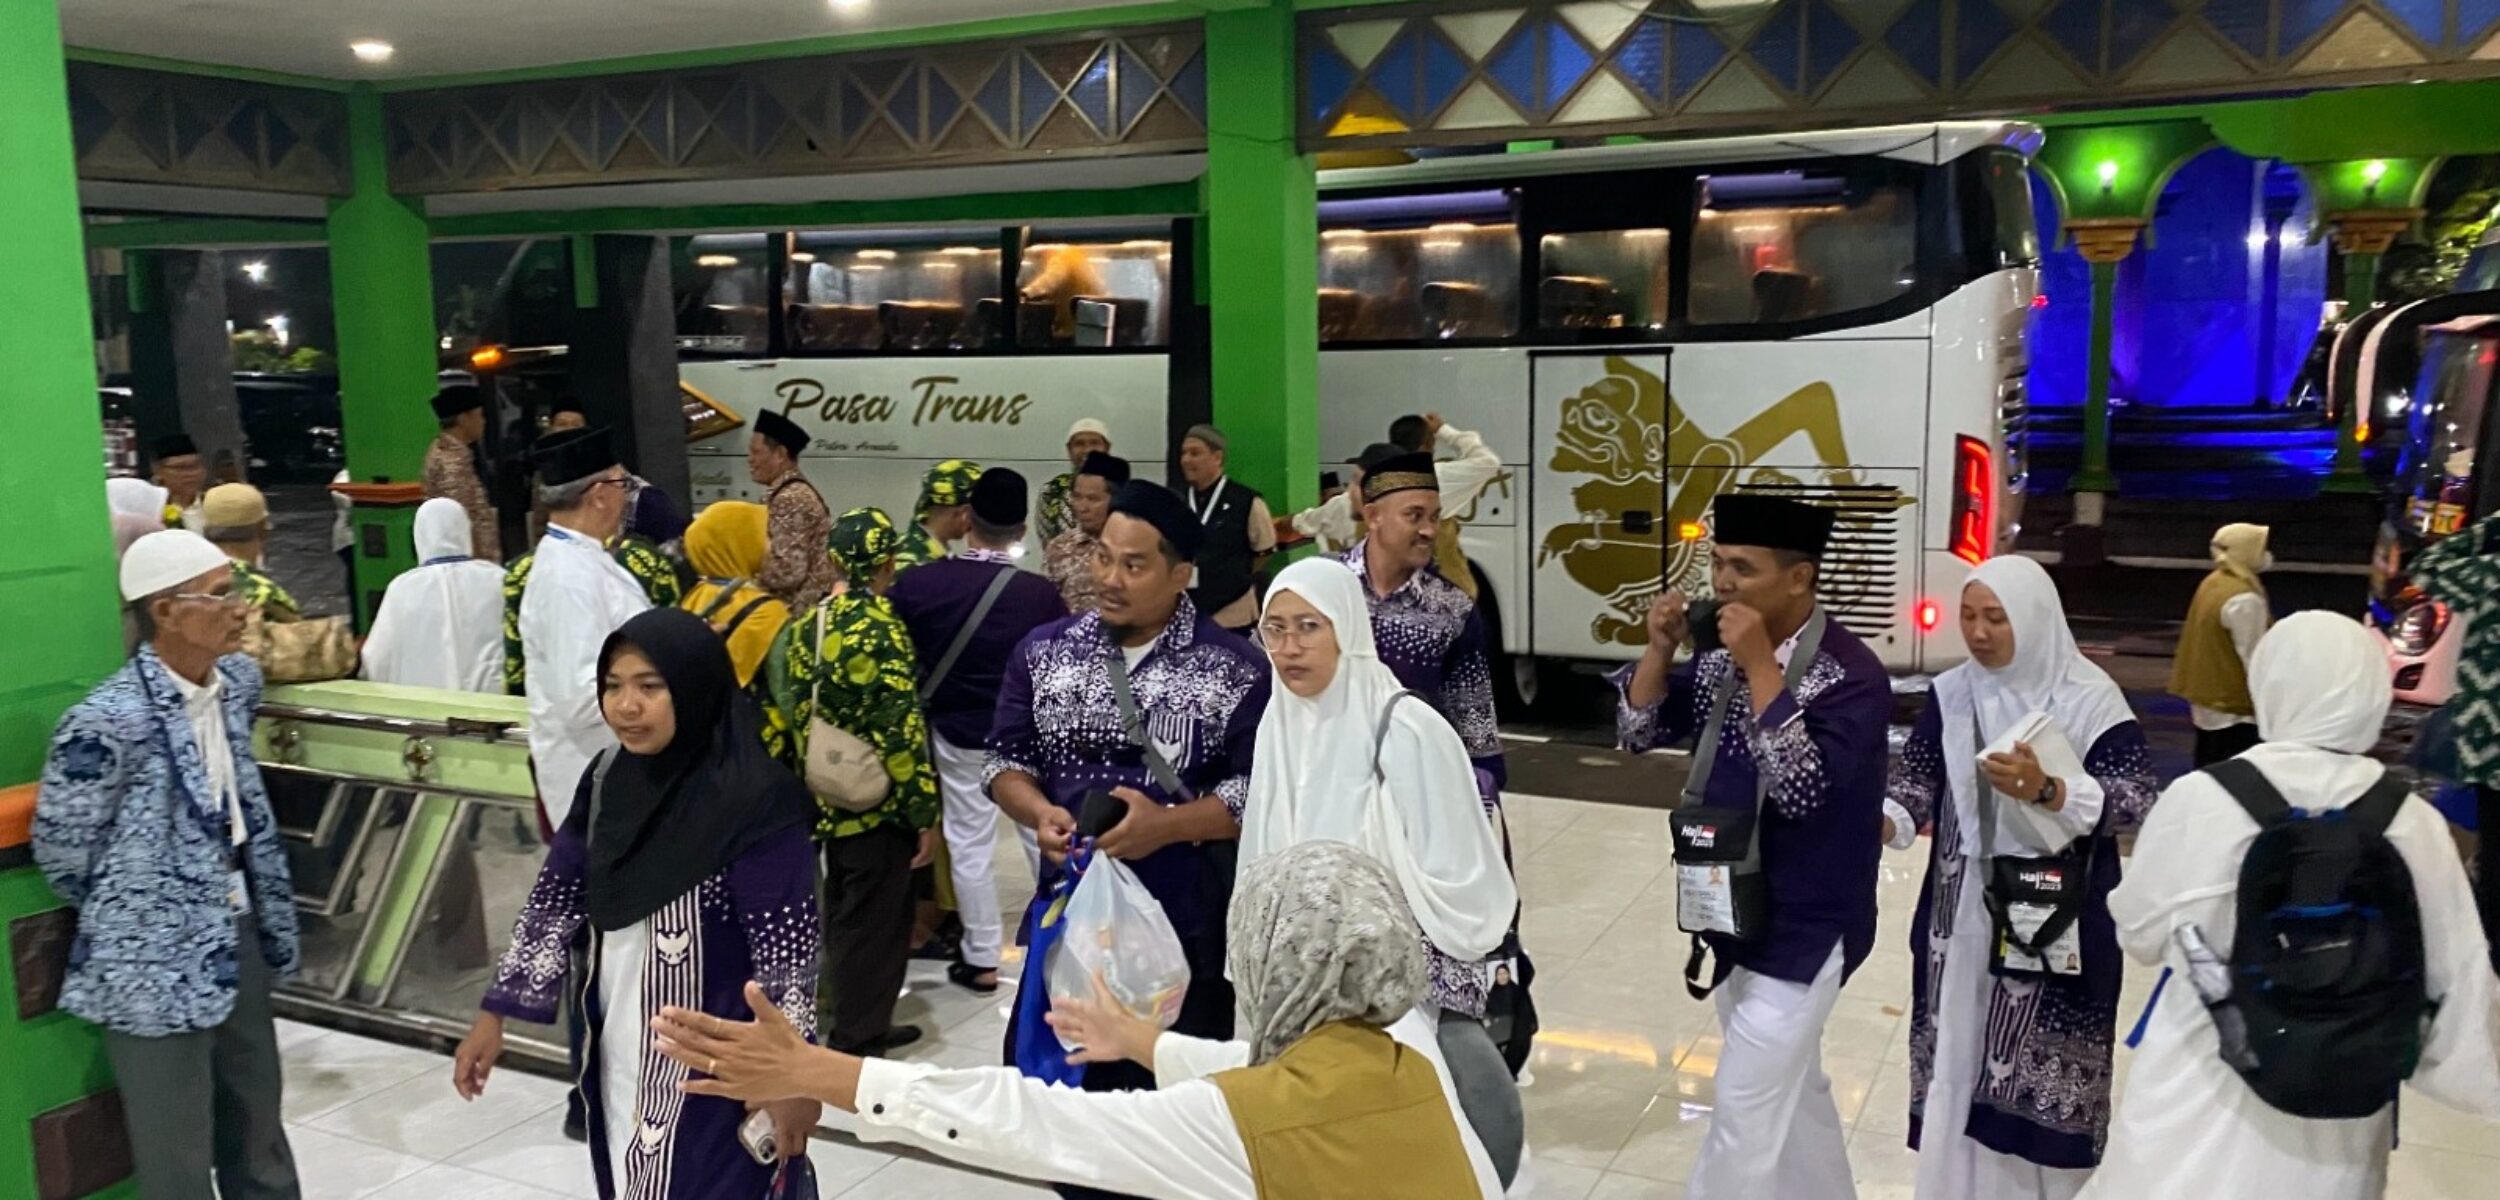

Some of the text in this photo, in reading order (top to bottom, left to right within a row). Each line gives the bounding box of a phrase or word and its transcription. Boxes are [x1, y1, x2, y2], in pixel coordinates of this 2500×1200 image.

[776, 376, 1032, 427] Pasa Trans
[1681, 824, 1704, 846] Haji
[2020, 872, 2044, 889] Haji
